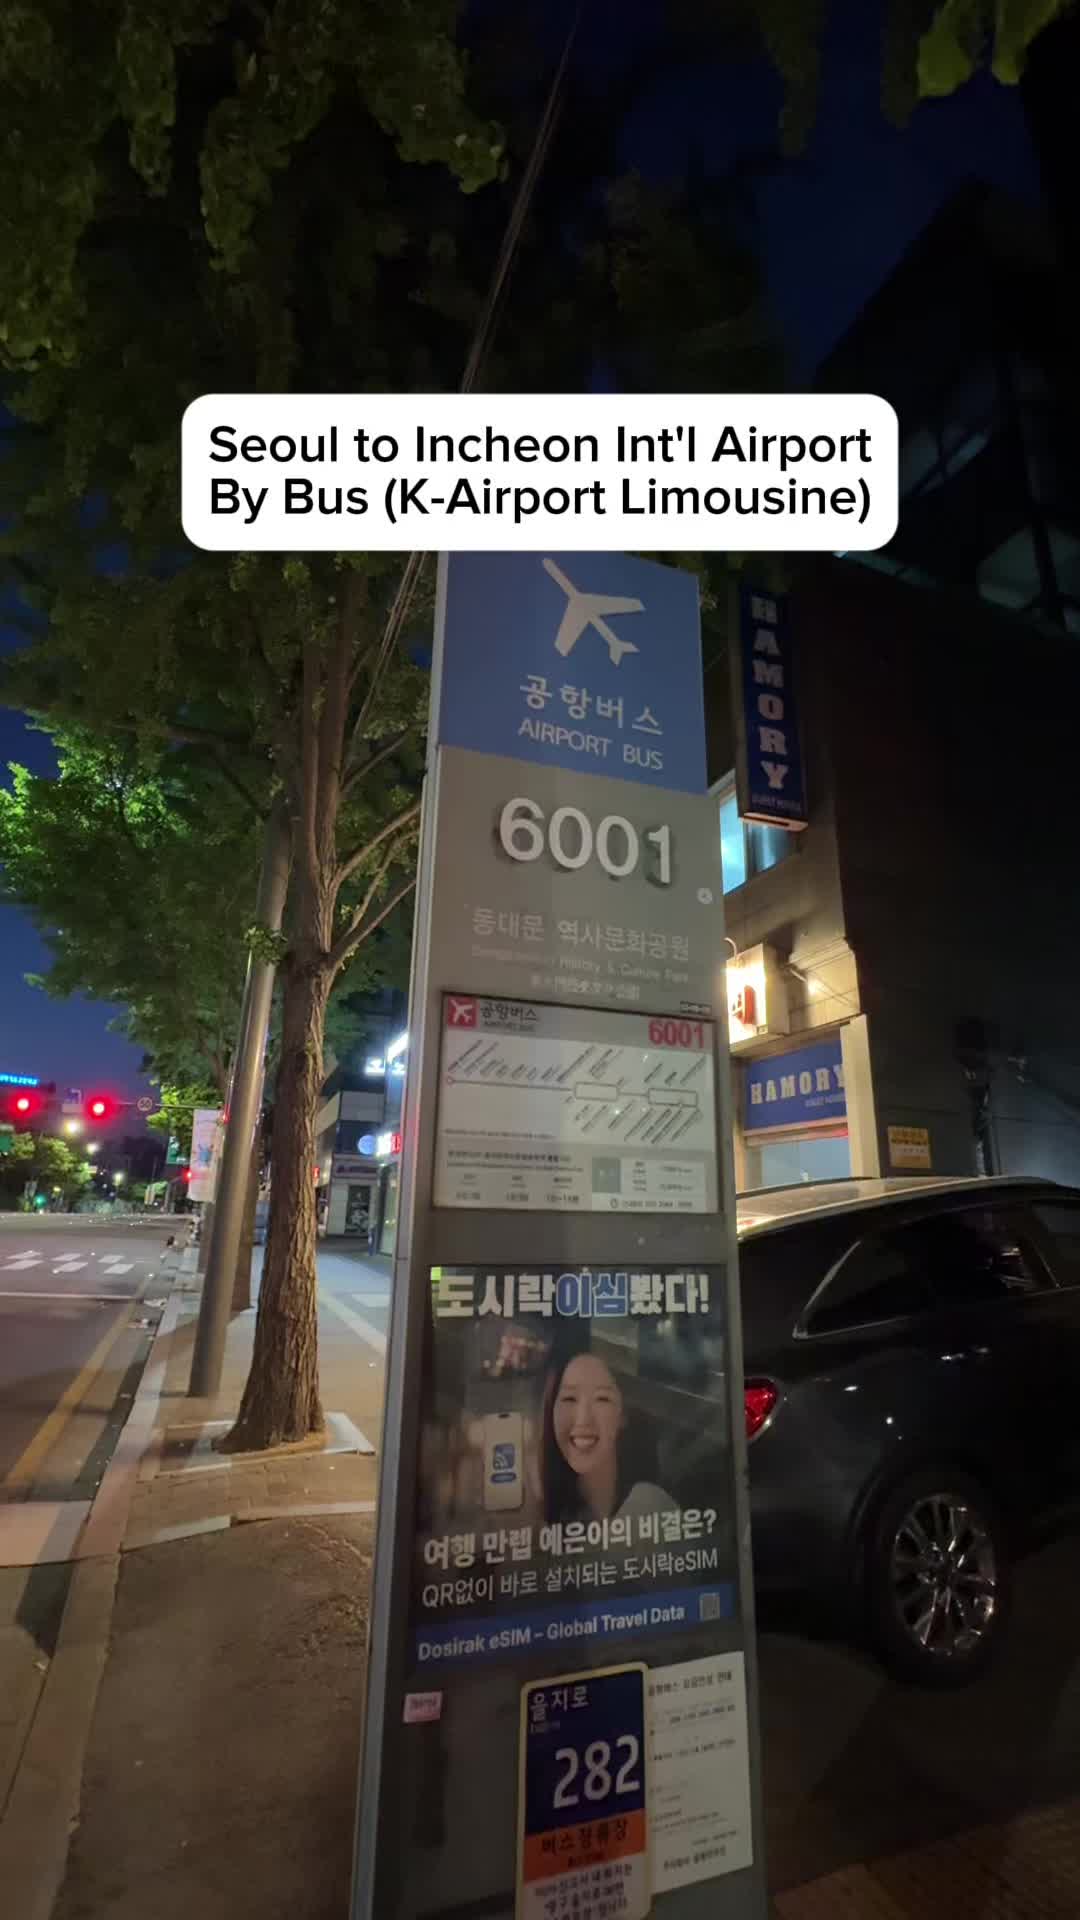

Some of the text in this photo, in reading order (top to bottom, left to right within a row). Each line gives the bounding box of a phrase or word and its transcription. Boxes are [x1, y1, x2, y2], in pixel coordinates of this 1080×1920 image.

[519, 674, 663, 736] 공항버스
[751, 595, 789, 790] HAMORY
[518, 717, 664, 770] AIRPORT BUS
[499, 797, 671, 884] 6001
[472, 907, 545, 942] 동대문
[557, 919, 689, 961] 역사문화공원
[480, 1001, 538, 1021] 공항버스
[647, 1020, 705, 1049] 6001
[750, 1063, 846, 1105] HAMORY
[423, 1509, 717, 1570] 여행 만렙 예은이의 비결은?
[422, 1549, 719, 1608] QR없이 바로 설치되는 도시락eSIM
[418, 1635, 486, 1661] Dosirak
[488, 1626, 531, 1650] eSIM
[546, 1615, 598, 1640] Global
[601, 1607, 648, 1632] Travel
[650, 1604, 685, 1623] Data
[529, 1684, 590, 1722] 을지로
[553, 1734, 641, 1810] 282
